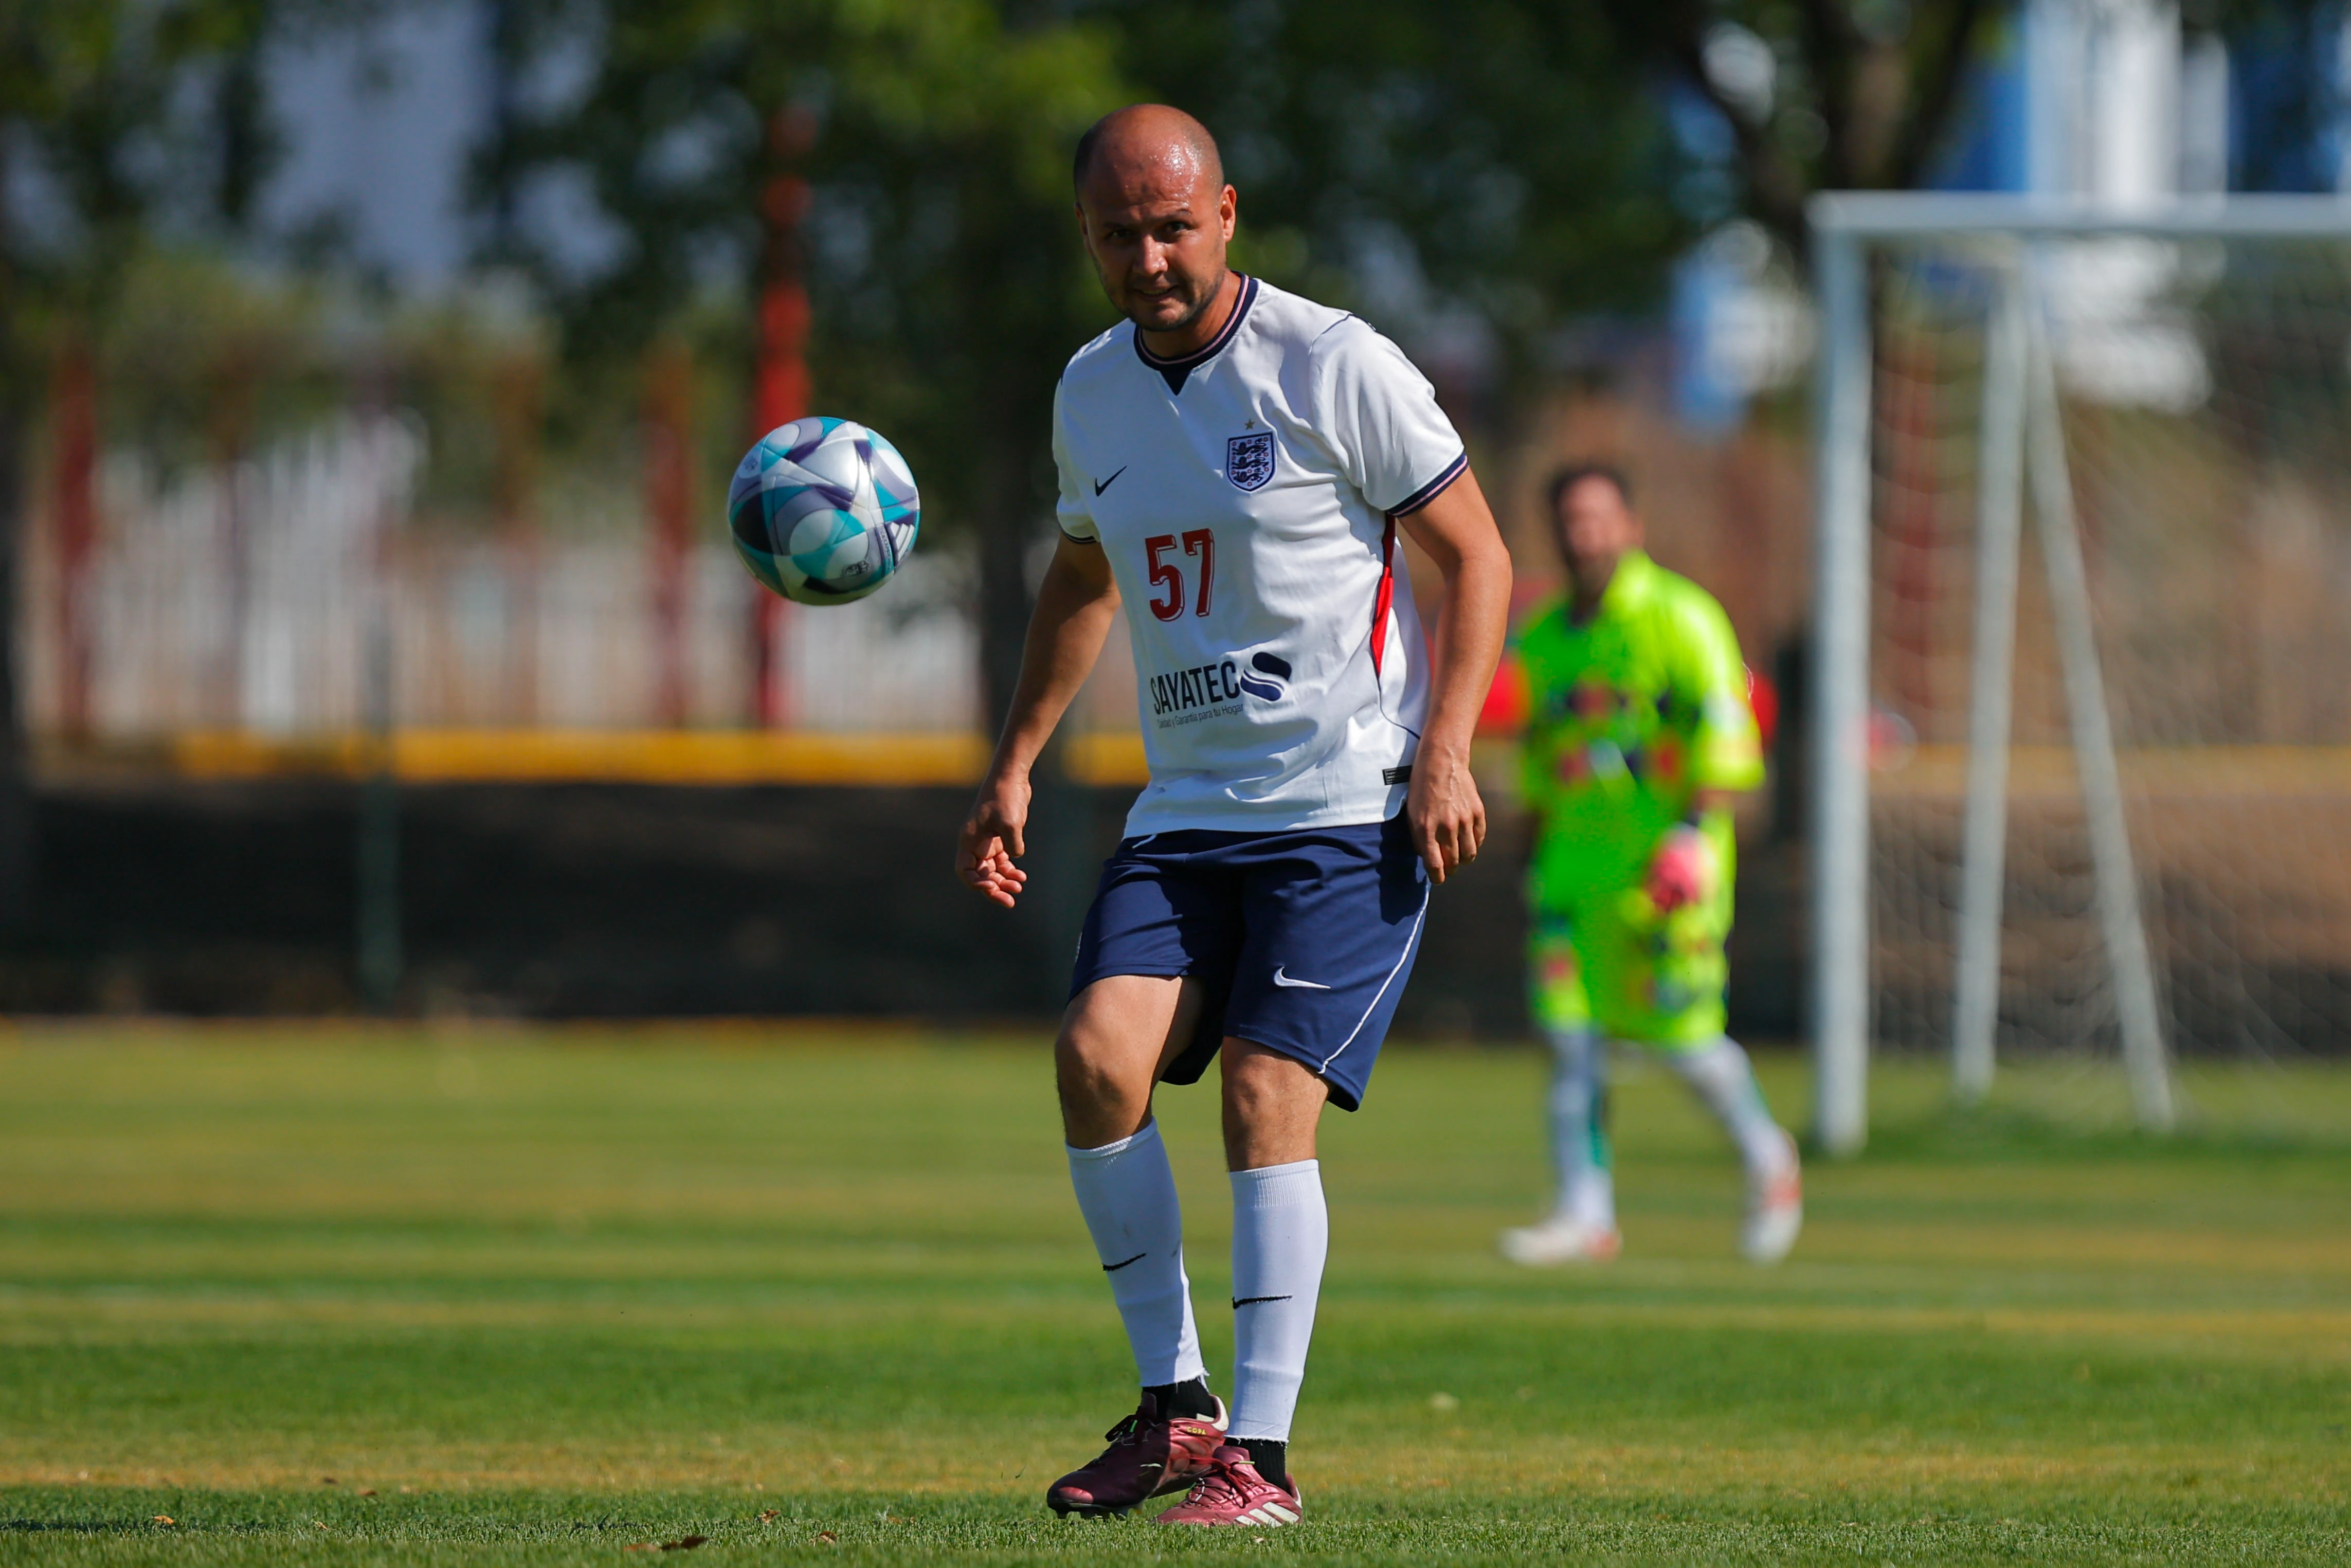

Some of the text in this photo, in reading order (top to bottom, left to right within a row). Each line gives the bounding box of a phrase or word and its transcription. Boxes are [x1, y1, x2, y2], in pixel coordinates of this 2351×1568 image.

[1145, 528, 1215, 622] 57
[1150, 660, 1241, 715] SAYATEC
[1198, 710, 1213, 723] para
[1214, 709, 1221, 717] tu
[1222, 704, 1244, 715] Hogar
[1187, 1426, 1206, 1435] COPA
